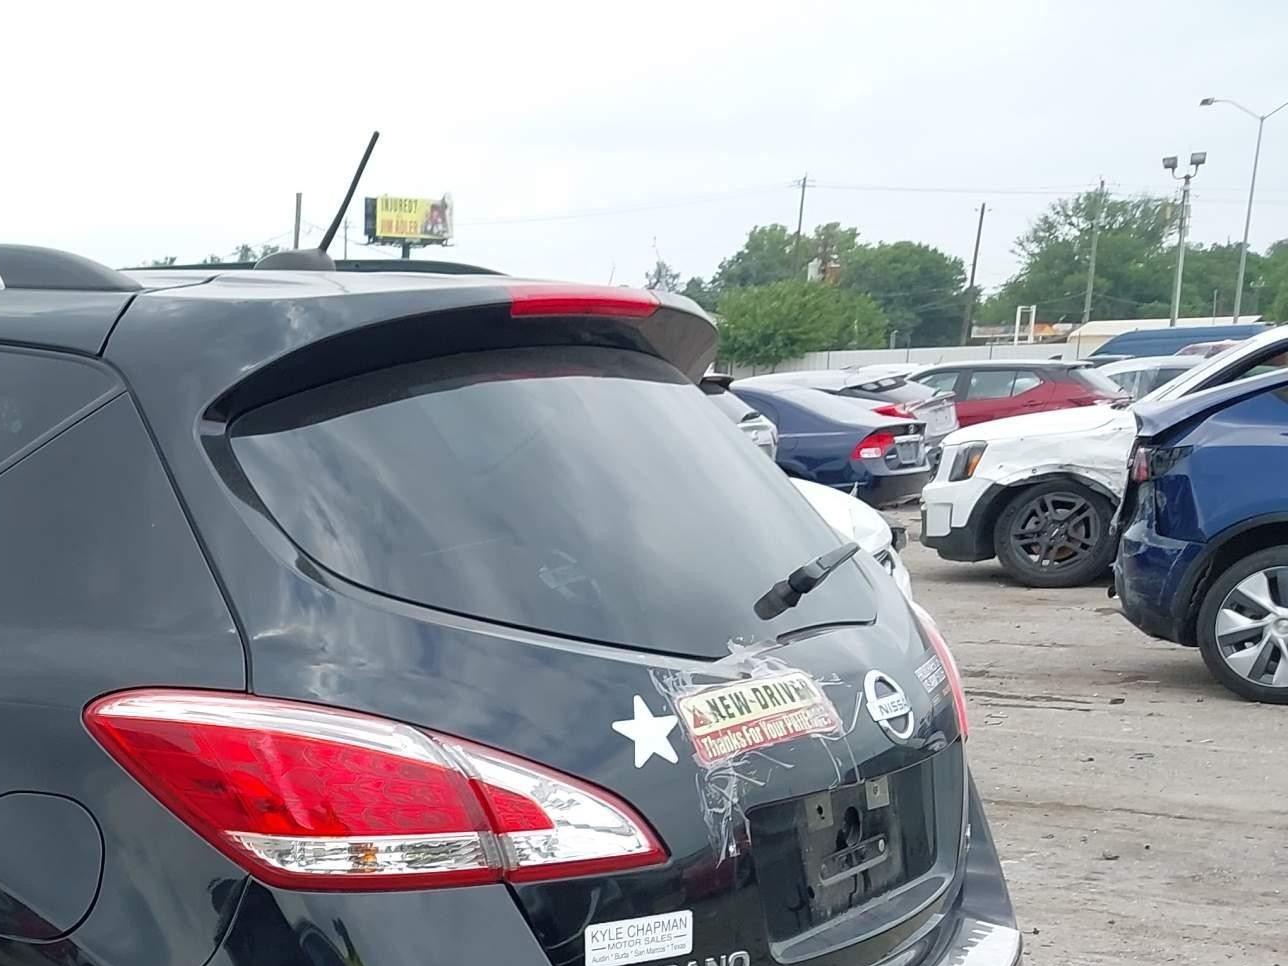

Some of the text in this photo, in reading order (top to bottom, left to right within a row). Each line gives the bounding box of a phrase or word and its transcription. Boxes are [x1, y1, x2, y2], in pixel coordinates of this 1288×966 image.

[700, 729, 745, 758] Thanks
[743, 724, 762, 746] For
[761, 719, 786, 743] Your
[591, 917, 688, 943] KYLE CHAPMAN
[607, 933, 673, 950] MOTOR SALES
